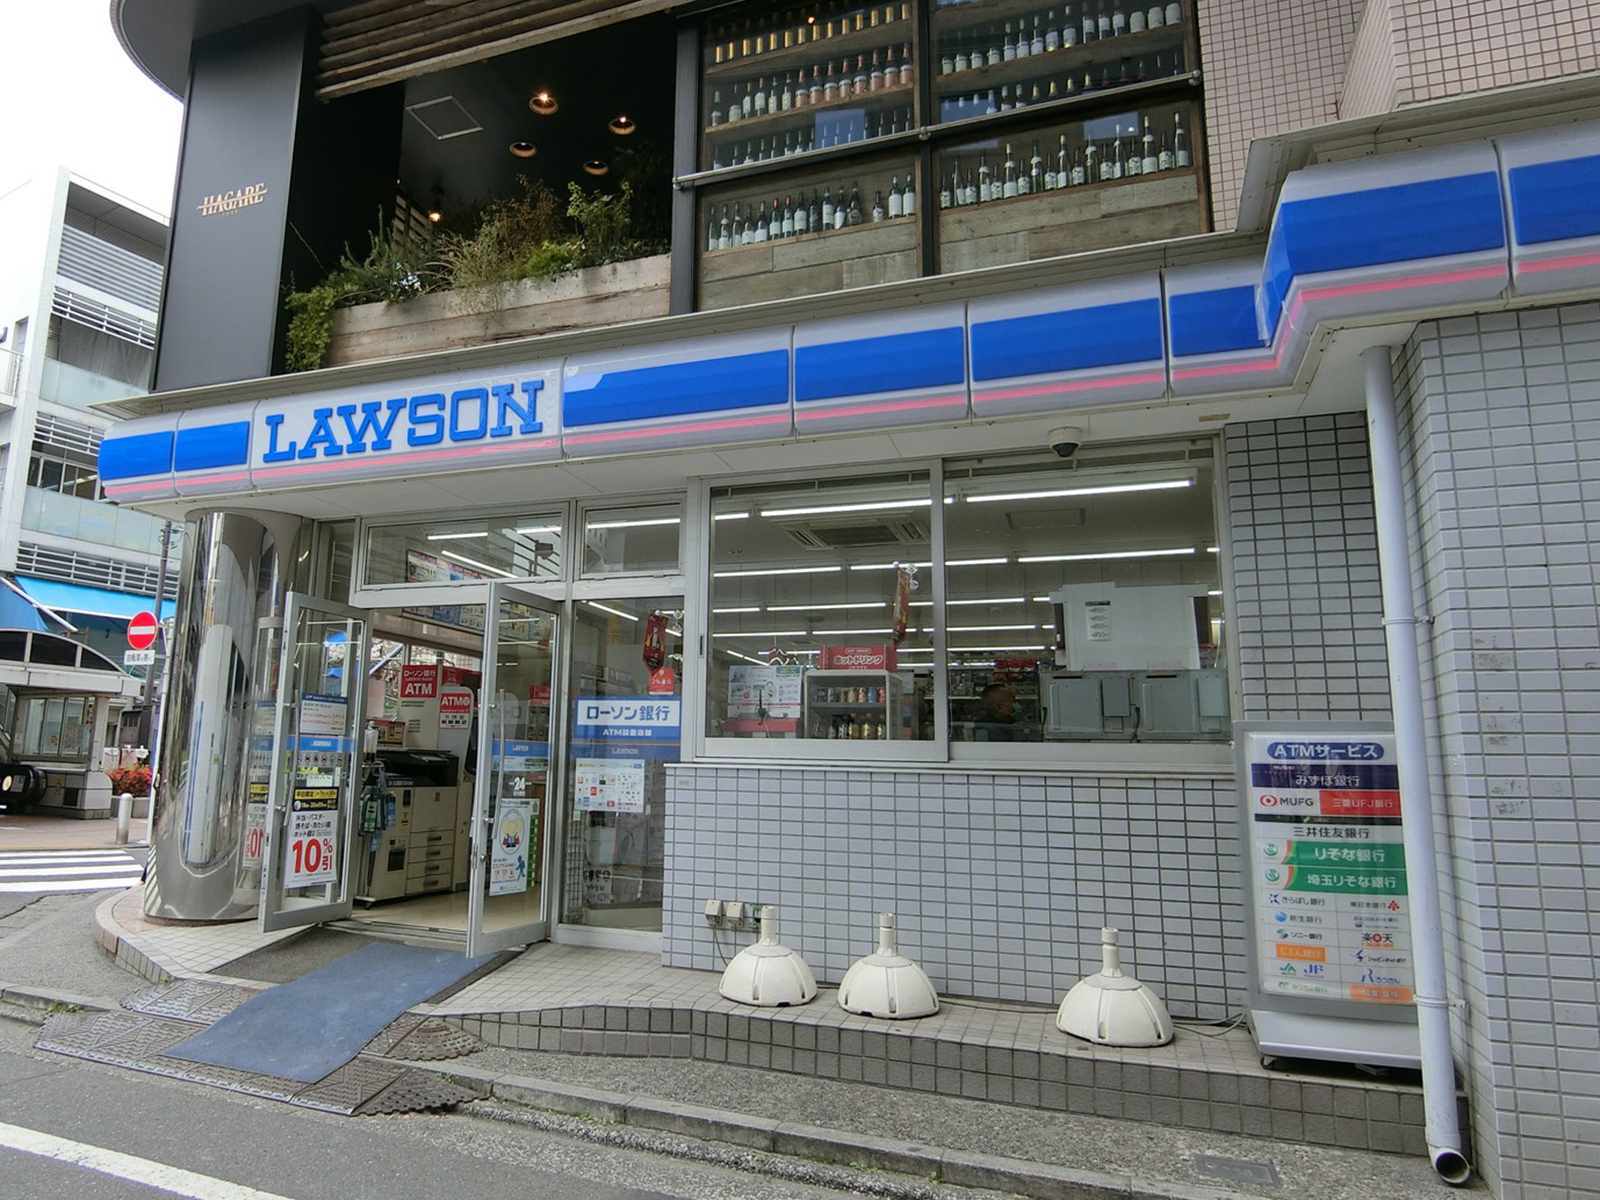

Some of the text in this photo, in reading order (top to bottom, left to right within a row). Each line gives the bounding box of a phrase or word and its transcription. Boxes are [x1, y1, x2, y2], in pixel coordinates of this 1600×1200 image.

[200, 183, 266, 216] HAGARE
[263, 379, 544, 463] LAWSON
[833, 655, 883, 665] ホットドリンク
[403, 669, 436, 677] ローソン銀行
[405, 683, 432, 695] ATM
[441, 696, 463, 706] ATM
[586, 705, 670, 721] ローソン銀行
[602, 728, 652, 737] ATM設置店舗
[1274, 744, 1378, 758] ATMサービス
[514, 776, 526, 791] 24
[1295, 774, 1360, 787] みずほ銀行
[1280, 797, 1314, 807] MUFG
[1332, 798, 1394, 808] 三菱UFJ銀行
[1293, 825, 1370, 839] 三井住友銀行
[1314, 847, 1386, 862] りそな銀行
[1307, 873, 1397, 889] 埼玉りそな銀行
